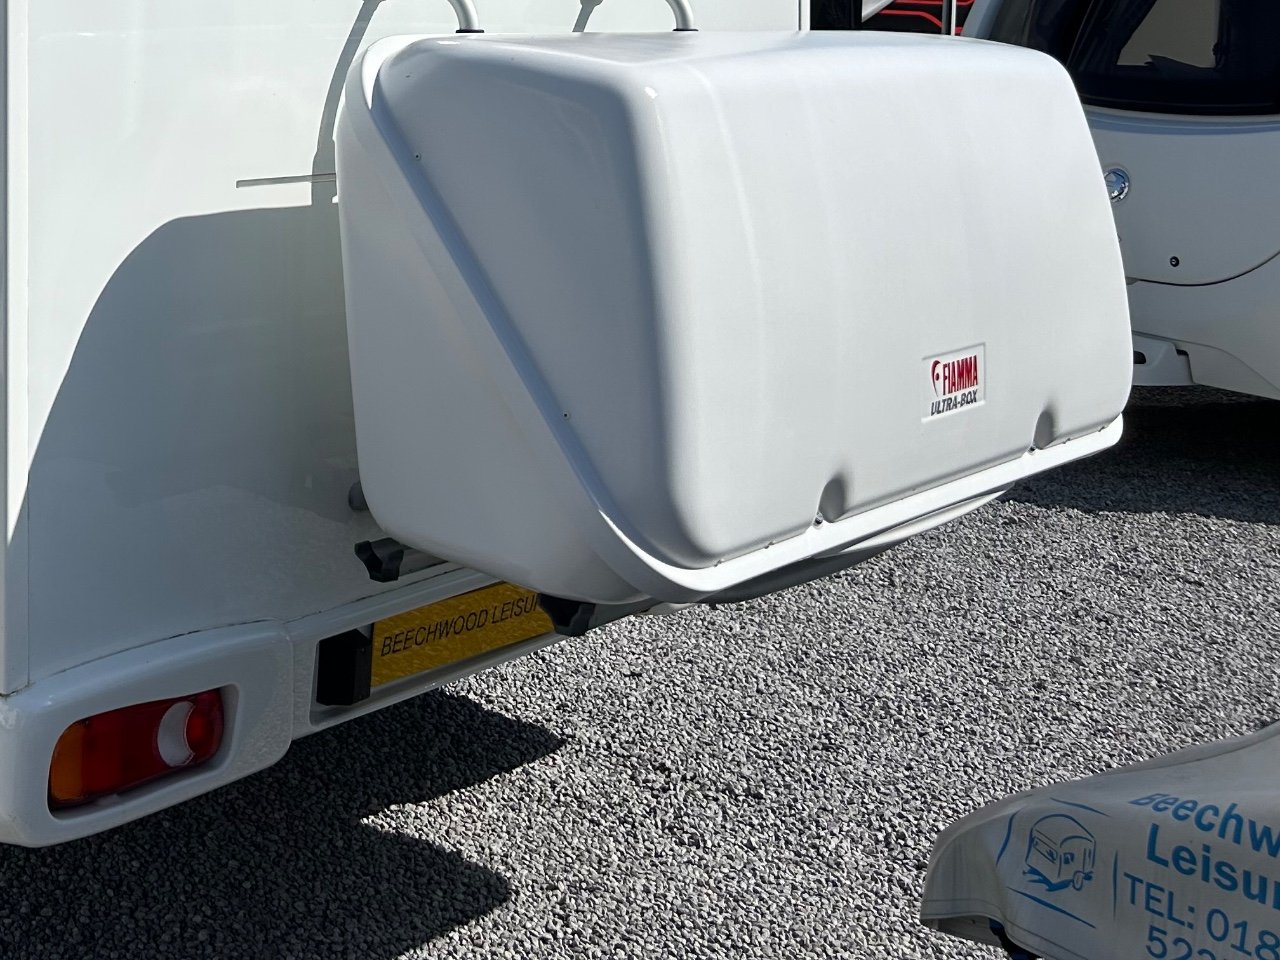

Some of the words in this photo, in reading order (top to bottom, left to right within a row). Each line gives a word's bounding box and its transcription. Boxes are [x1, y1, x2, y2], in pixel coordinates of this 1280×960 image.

[943, 354, 979, 396] FIAMMA
[930, 388, 978, 417] ULTRA-BOX
[380, 609, 488, 657] BEECHWOOD
[1128, 793, 1280, 858] Beechw
[1123, 871, 1195, 930] TEL:
[1206, 908, 1280, 960] 018
